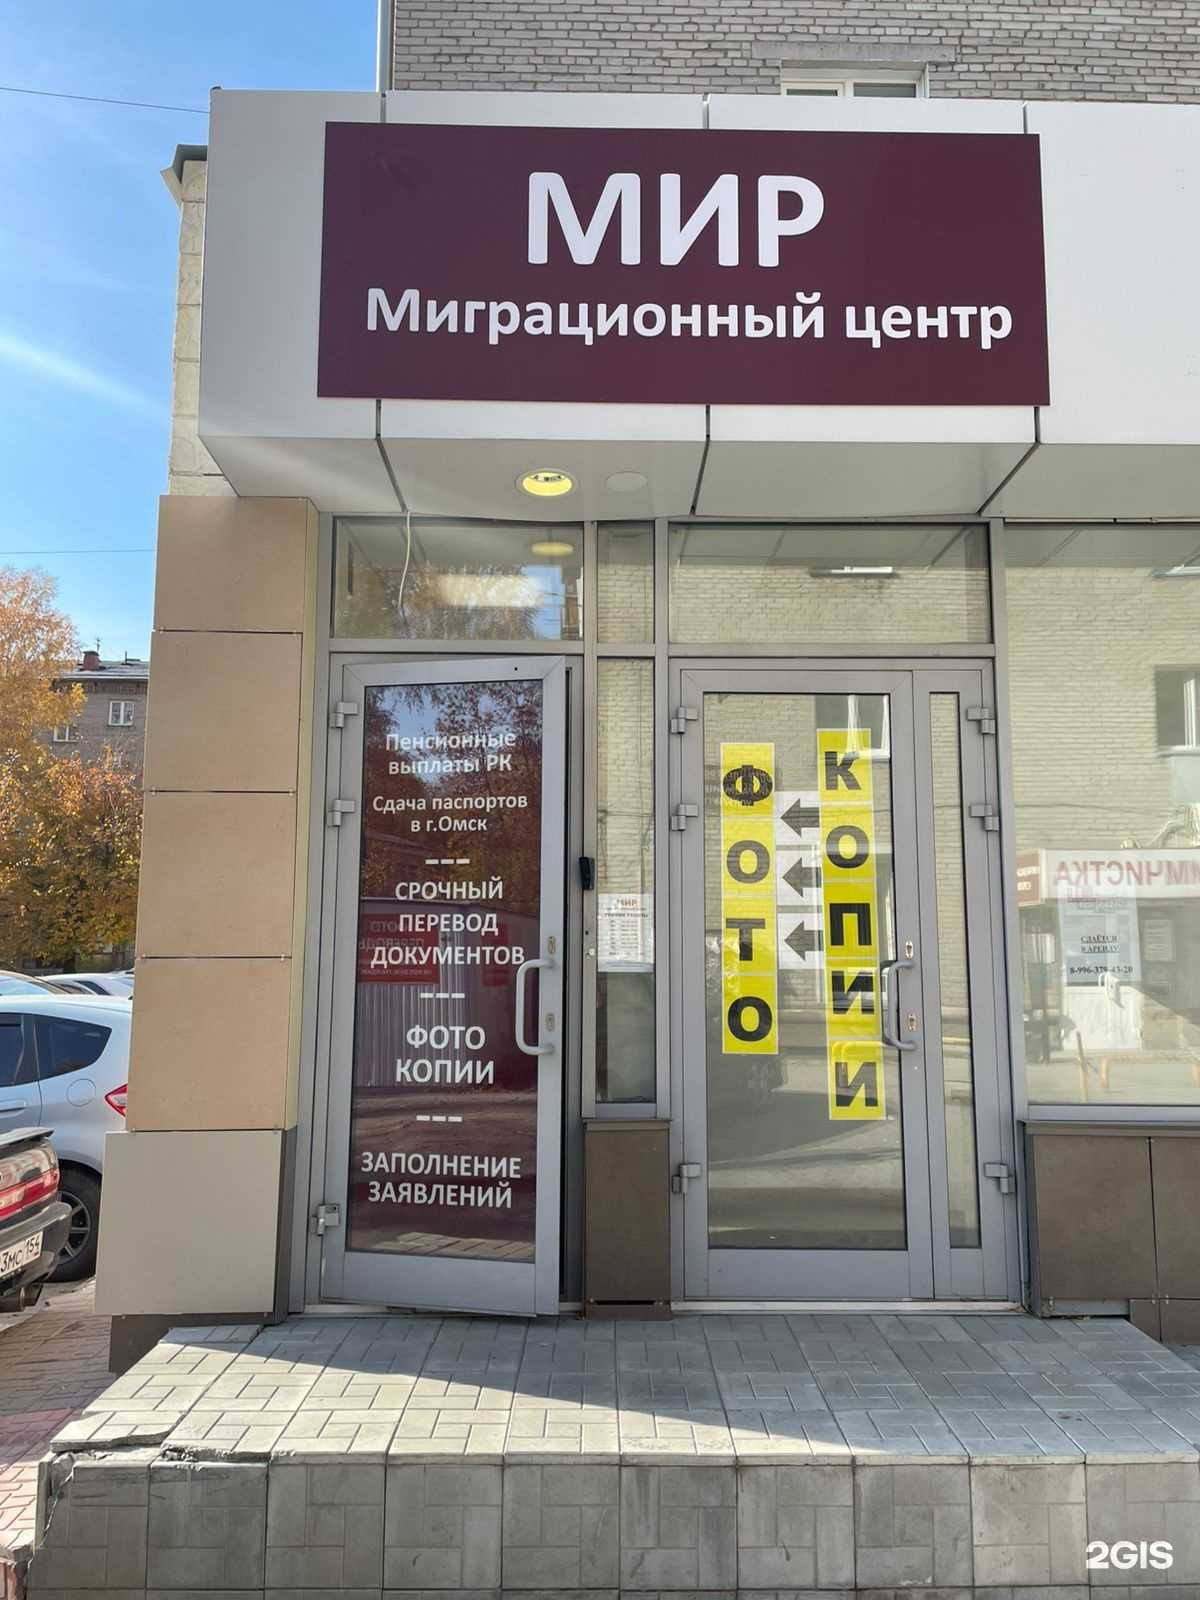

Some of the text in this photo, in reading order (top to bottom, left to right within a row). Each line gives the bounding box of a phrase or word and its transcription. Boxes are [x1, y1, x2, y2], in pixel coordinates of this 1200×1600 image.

[527, 171, 825, 268] МИР
[366, 287, 1013, 350] Миграционный центр
[385, 731, 517, 752] Пенсионные
[388, 754, 513, 775] выплаты РК
[372, 794, 528, 815] Сдача паспортов
[410, 816, 488, 832] в г.Омск
[395, 876, 503, 901] СРОЧНЫЙ
[723, 765, 773, 1042] ФОТО
[399, 913, 499, 936] ПЕРЕВОД
[824, 751, 879, 1108] КОПИИ
[371, 946, 525, 969] ДОКУМЕНТОВ
[406, 1024, 486, 1050] ФОТО
[396, 1058, 495, 1084] КОПИИ
[360, 1151, 522, 1179] ЗАПОЛНЕНИЕ
[367, 1180, 513, 1209] ЗАЯВЛЕНИЙ
